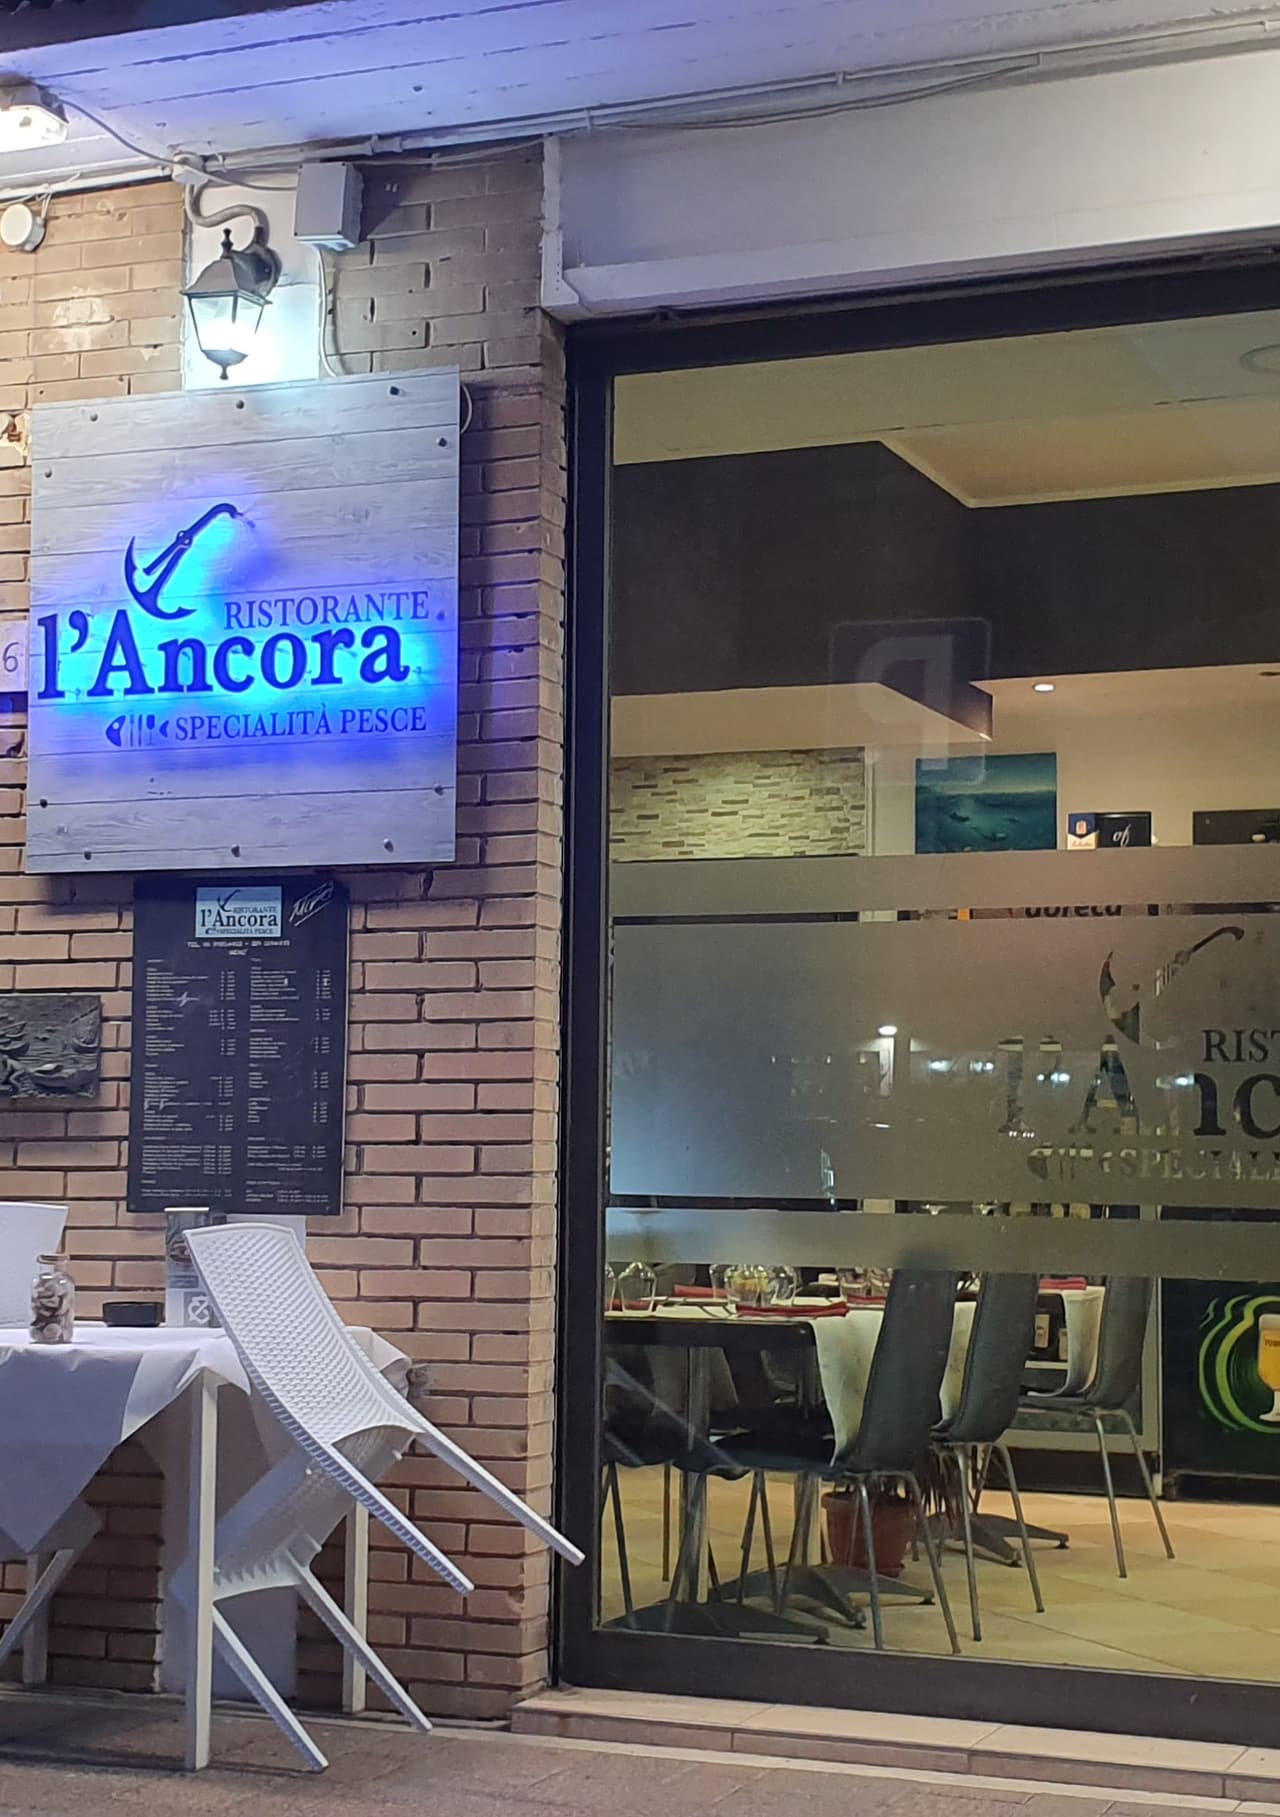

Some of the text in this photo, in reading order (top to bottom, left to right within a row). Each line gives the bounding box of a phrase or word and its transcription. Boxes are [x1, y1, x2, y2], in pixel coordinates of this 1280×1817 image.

[224, 591, 430, 630] RISTORANTE
[37, 609, 411, 700] l'Ancora
[176, 702, 427, 742] SPECIALITÀ PESCE
[200, 908, 278, 928] l'Ancora
